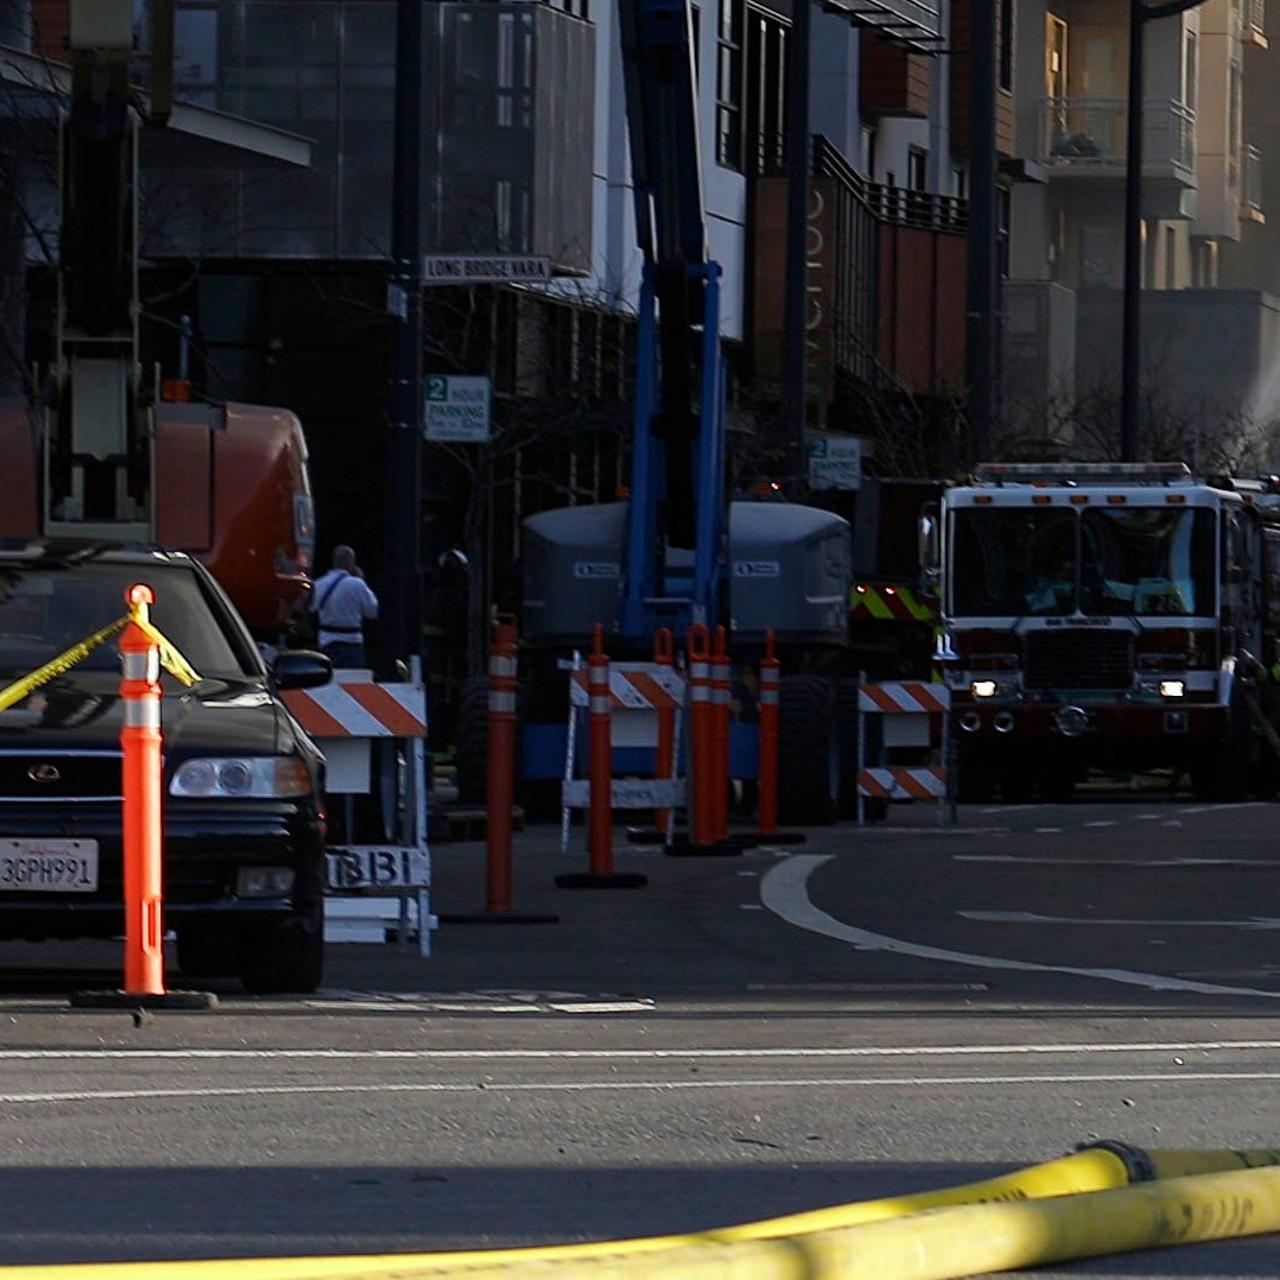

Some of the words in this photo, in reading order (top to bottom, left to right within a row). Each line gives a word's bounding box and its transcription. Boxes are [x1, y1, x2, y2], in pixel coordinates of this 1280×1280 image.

[428, 259, 462, 278] LONG
[464, 259, 507, 278] BRIDGE
[430, 378, 444, 399] 2
[1, 858, 92, 885] 3GPH991
